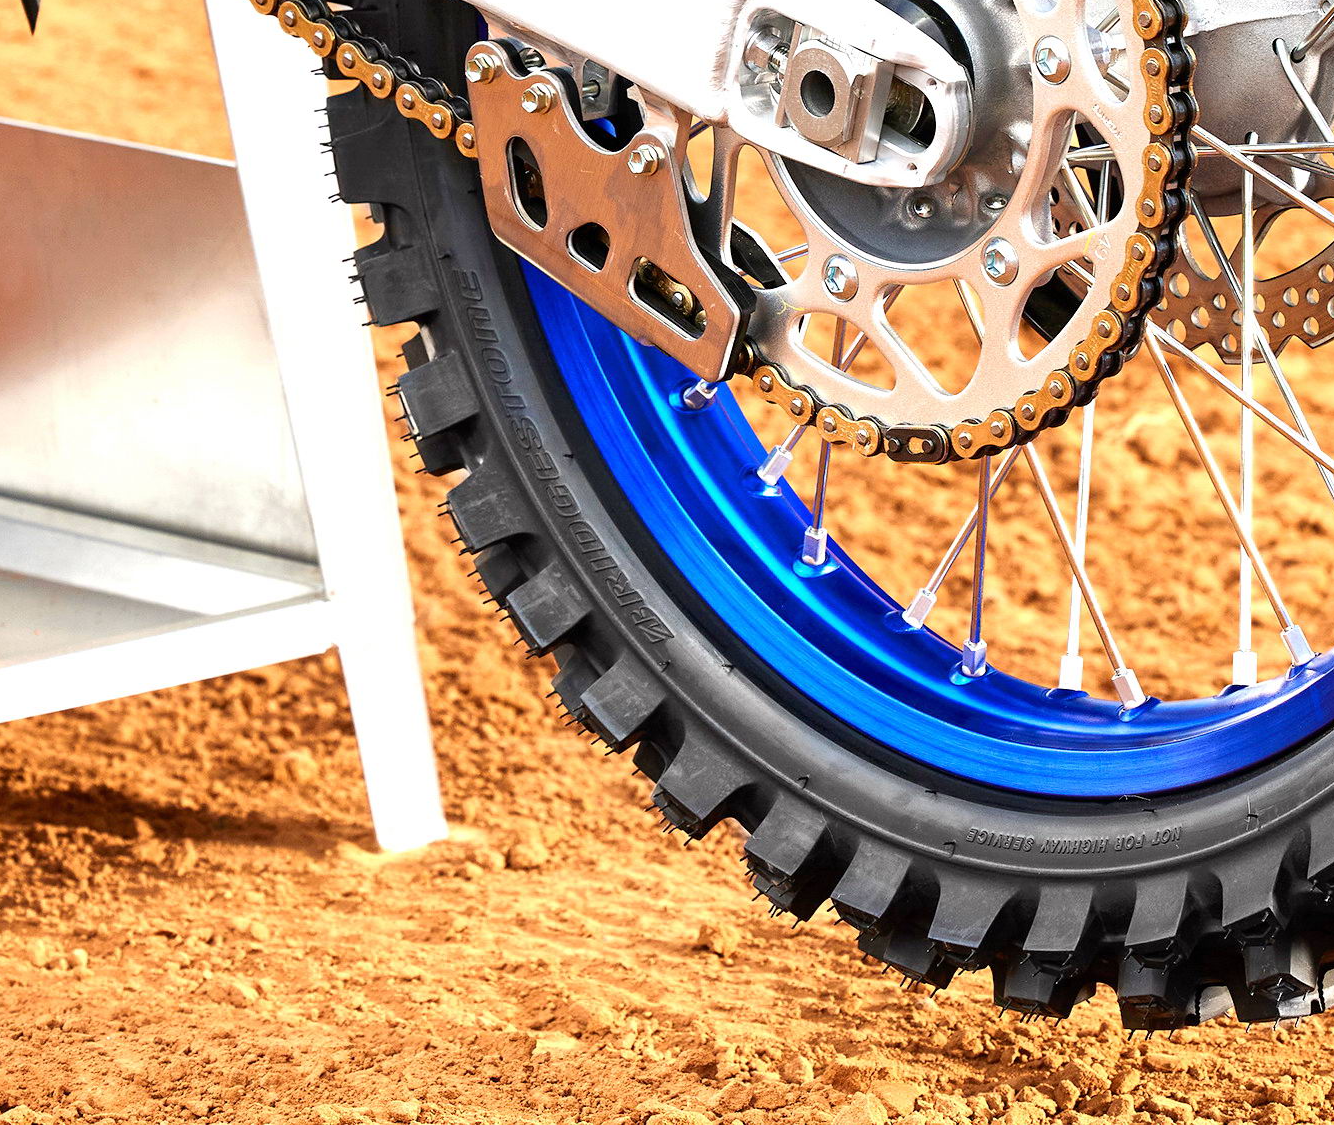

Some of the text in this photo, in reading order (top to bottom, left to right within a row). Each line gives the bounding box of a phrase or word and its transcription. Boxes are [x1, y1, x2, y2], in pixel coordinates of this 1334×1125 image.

[456, 269, 675, 644] BRIDGESTONE
[966, 826, 1183, 855] NOT FOR HIGHWAY SERVICE
